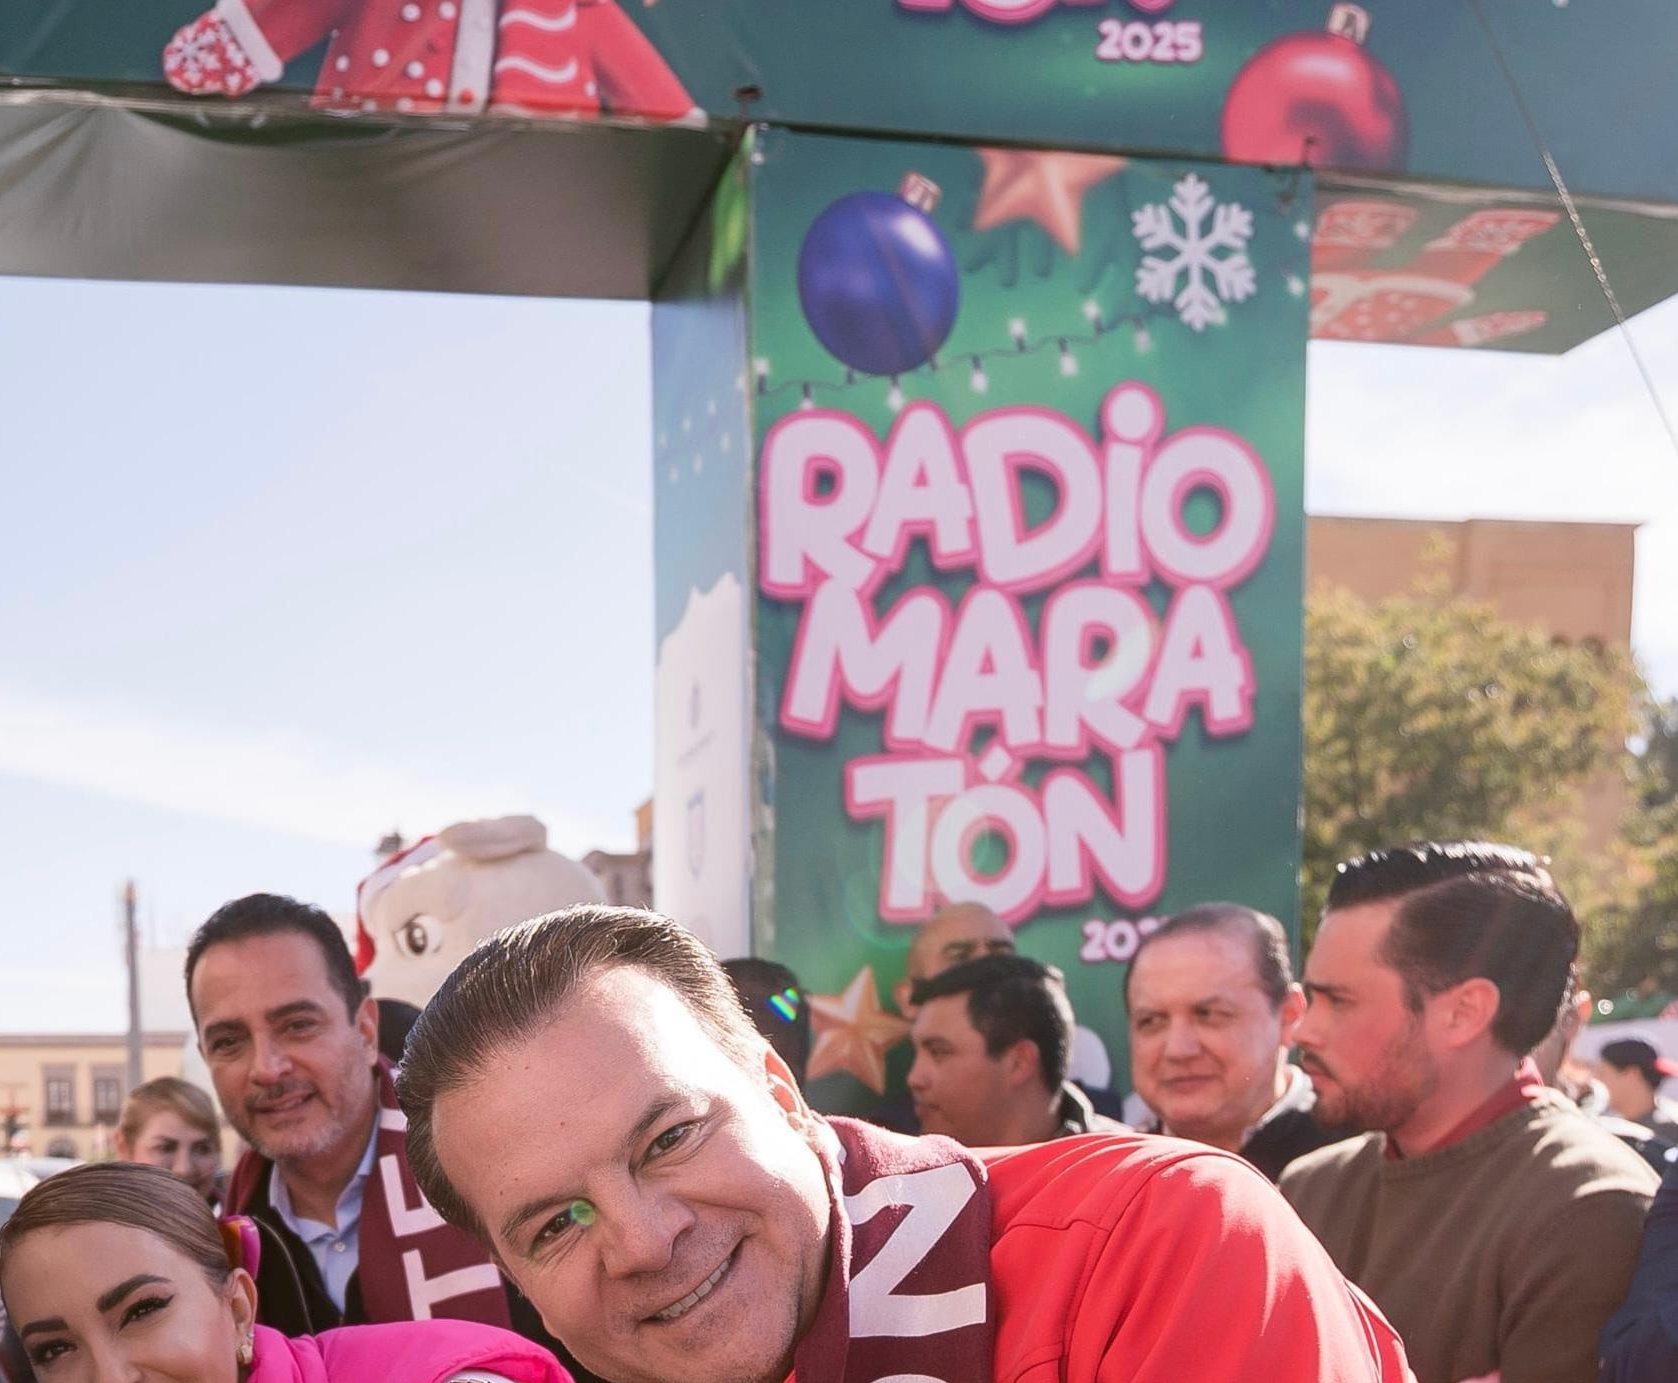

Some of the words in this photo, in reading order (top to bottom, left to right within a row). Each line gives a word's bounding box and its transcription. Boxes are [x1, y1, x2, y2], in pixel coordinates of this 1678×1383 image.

[1095, 18, 1204, 62] 2025
[780, 577, 1256, 757] MARA
[845, 742, 1168, 923] TÓN
[1080, 916, 1172, 963] 20
